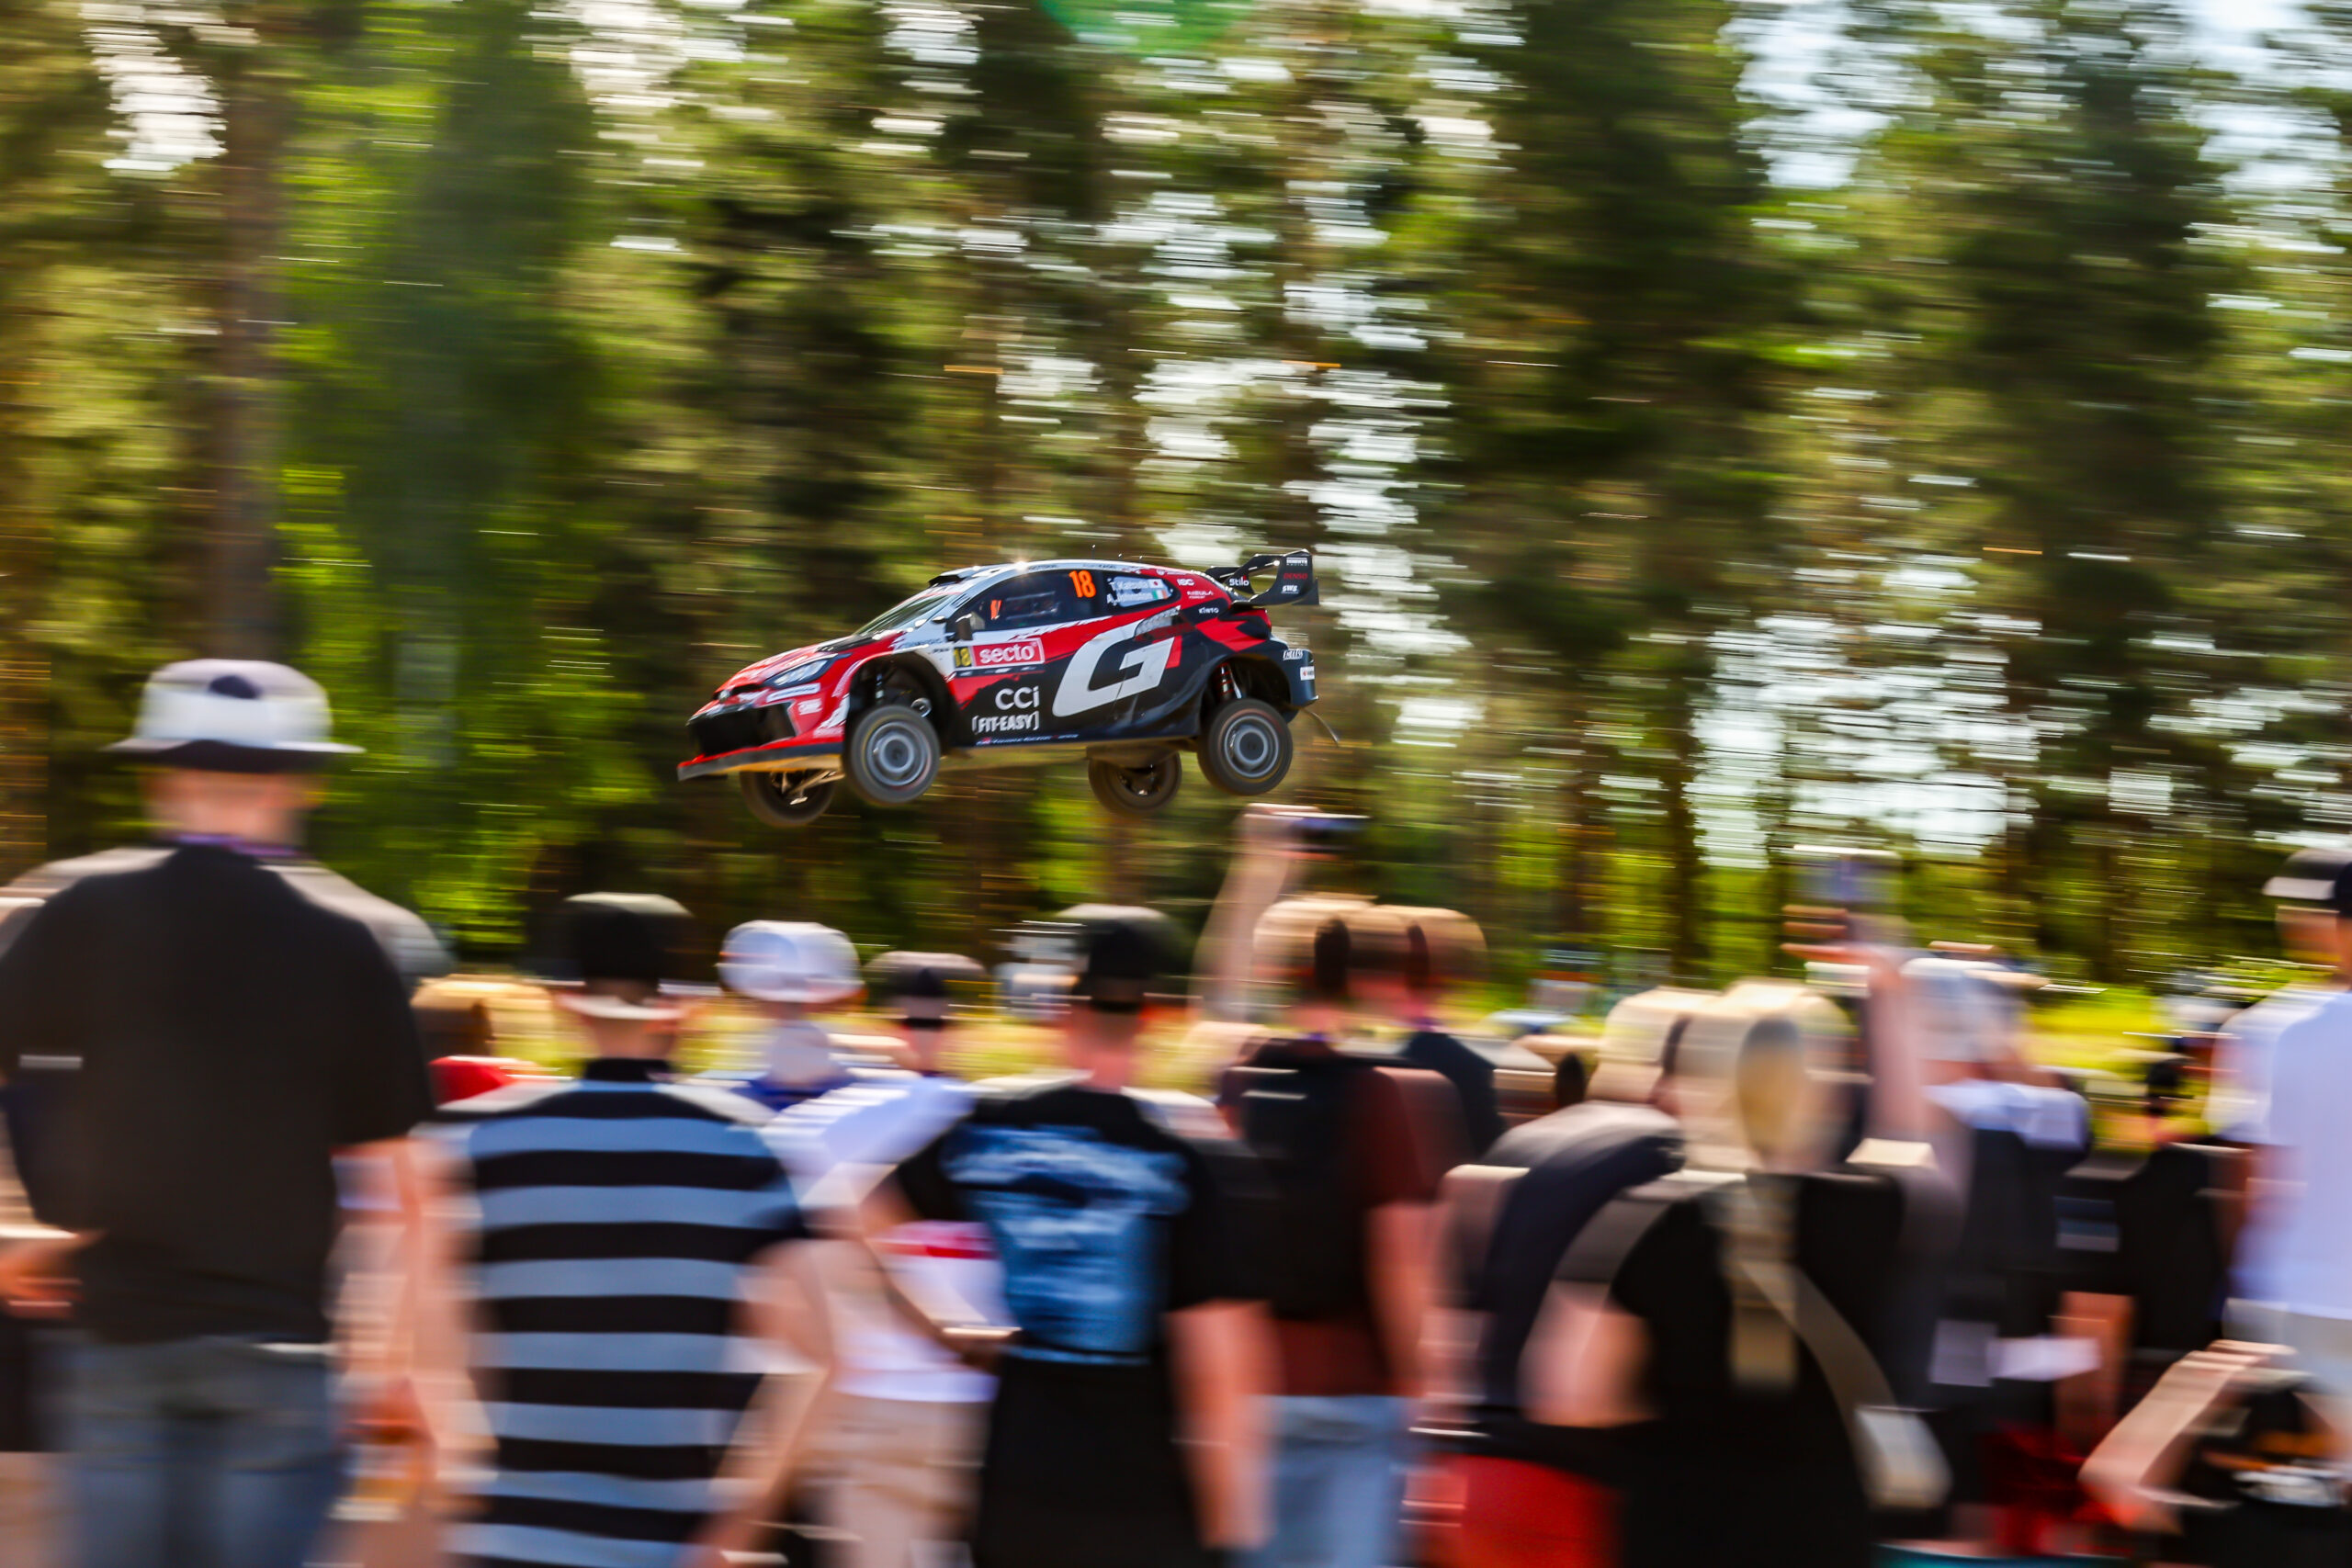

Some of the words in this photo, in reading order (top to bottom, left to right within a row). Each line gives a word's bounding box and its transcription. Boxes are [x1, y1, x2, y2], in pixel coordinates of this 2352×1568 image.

[1069, 570, 1097, 598] 18
[1229, 575, 1250, 586] Stilo
[1283, 572, 1308, 581] DENSO
[953, 647, 972, 667] 18
[979, 643, 1035, 664] secto
[1052, 617, 1175, 717] G
[994, 685, 1040, 710] CCi
